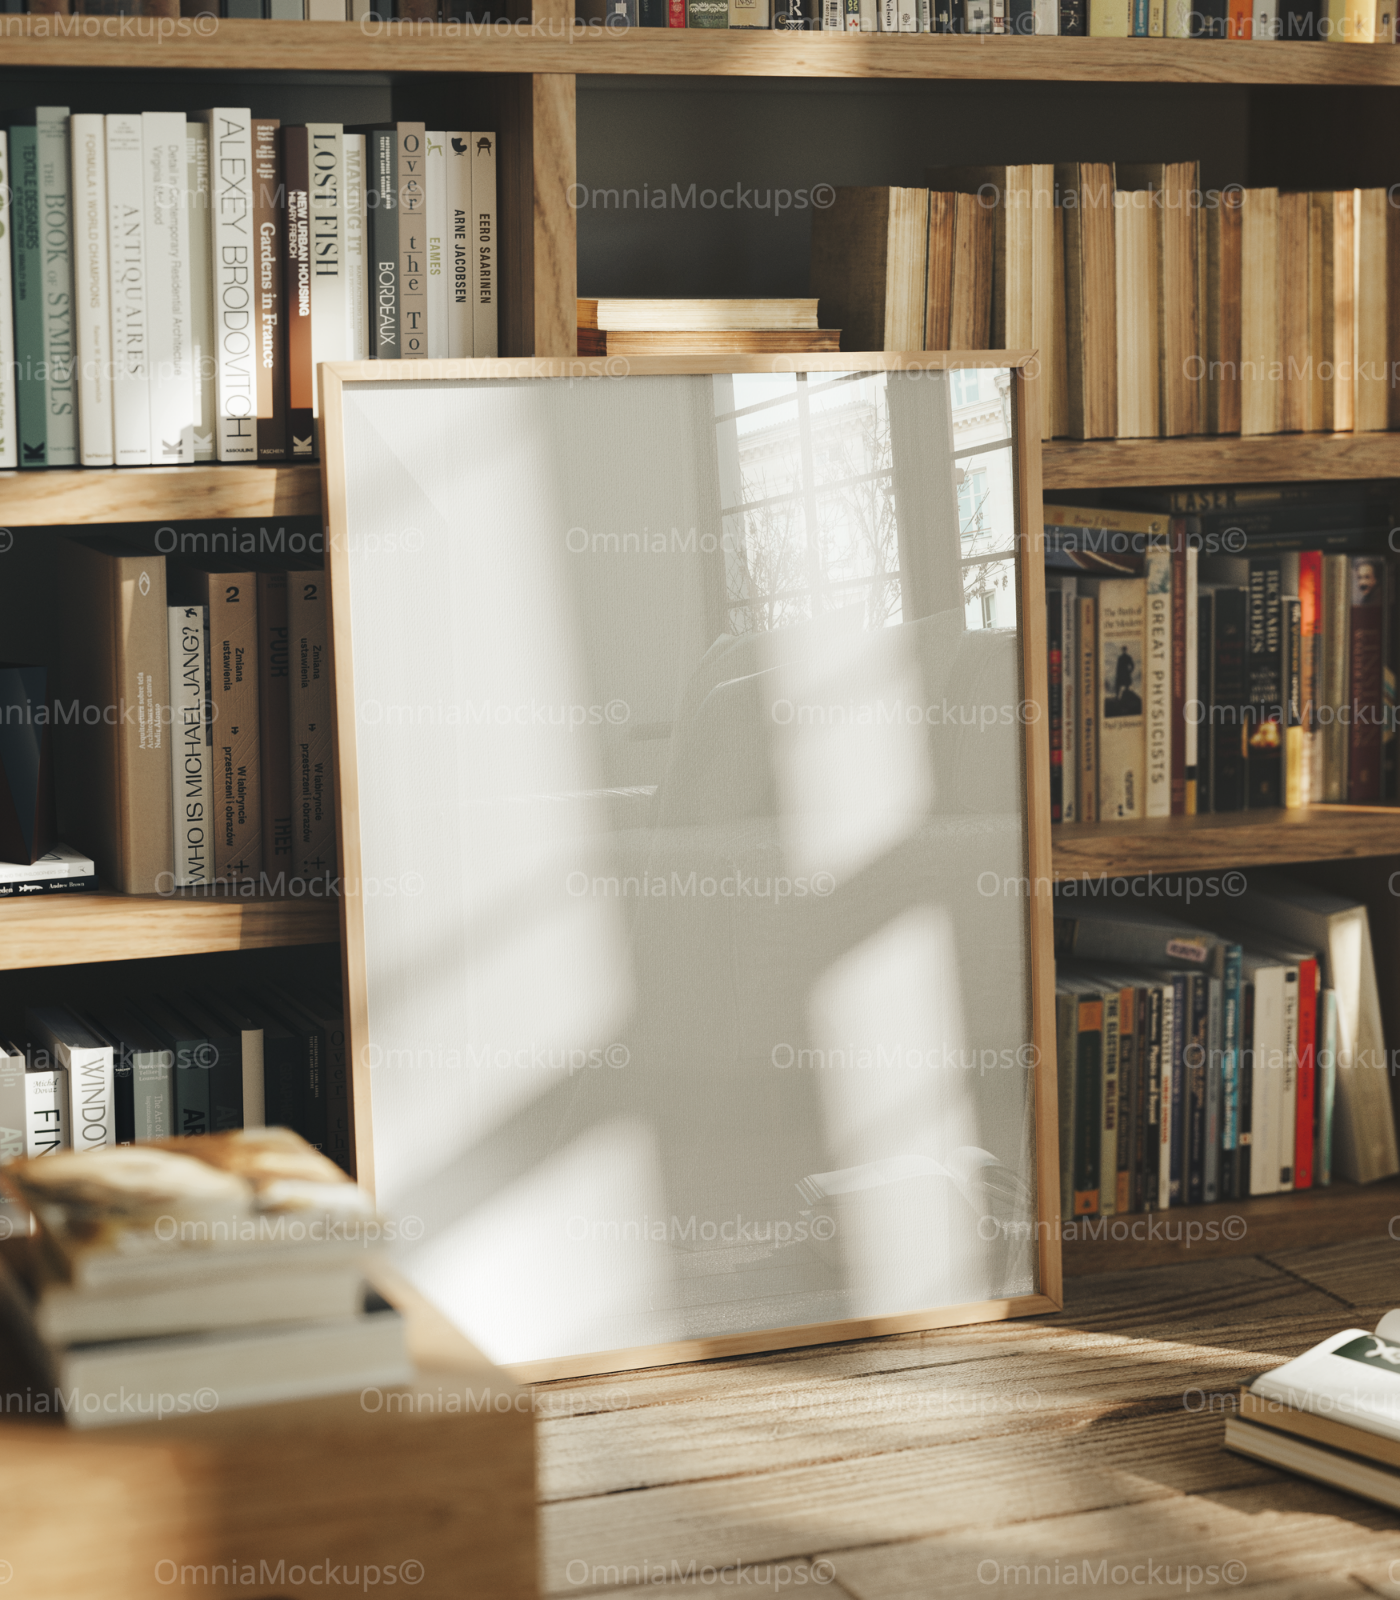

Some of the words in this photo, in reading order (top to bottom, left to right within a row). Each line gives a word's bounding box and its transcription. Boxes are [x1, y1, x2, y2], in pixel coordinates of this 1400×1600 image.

[23, 145, 37, 186] TEXTILE
[44, 163, 55, 187] THE
[86, 134, 98, 187] FORMULA
[151, 145, 164, 182] Virginia
[168, 145, 180, 173] Detail
[218, 117, 249, 234] ALEXEY
[313, 133, 338, 207] LOST
[404, 135, 420, 210] Over
[170, 176, 180, 185] in
[346, 149, 362, 230] MAKING
[25, 189, 40, 250] DESIGNERS
[88, 199, 100, 240] WORLD
[153, 185, 165, 225] McLeod
[168, 188, 182, 258] Contemporary
[288, 191, 297, 222] HILARY
[297, 191, 307, 218] NEW
[454, 209, 466, 239] ARNE
[45, 193, 68, 263] BOOK
[289, 223, 297, 259] FRENCH
[298, 220, 309, 261] URBAN
[314, 214, 340, 278] FISH
[347, 235, 362, 255] IT
[479, 213, 491, 243] EERO
[89, 243, 102, 309] CHAMPIONS
[259, 222, 277, 289] Gardens
[407, 235, 420, 290] the
[430, 237, 441, 276] EAMES
[454, 244, 467, 304] JACOBSEN
[479, 246, 492, 304] SAARINEN
[48, 270, 58, 286] OF
[120, 205, 145, 375] ANTIQUAIRES
[170, 260, 183, 314] Residential
[299, 264, 310, 317] HOUSING
[261, 293, 277, 309] in
[379, 262, 396, 346] BORDEAUX
[48, 292, 73, 416] SYMBOLS
[171, 317, 184, 376] Architecture
[222, 246, 252, 438] BRODOVITCH
[262, 313, 278, 369] France
[1172, 490, 1237, 513] LASER
[225, 586, 240, 602] 2
[303, 584, 318, 600] 2
[1250, 570, 1265, 653] RHODES
[1151, 599, 1166, 660] GREAT
[181, 626, 201, 697] JANG?
[222, 640, 234, 691] ustawienia
[234, 647, 245, 683] Zmiana
[300, 638, 311, 689] ustawienia
[312, 645, 322, 680] Zmiana
[137, 686, 145, 705] sobre
[145, 674, 153, 698] canvas
[146, 697, 153, 708] on
[1151, 671, 1166, 784] PHYSICISTS
[183, 699, 203, 798] MICHAEL
[314, 763, 324, 773] W
[222, 746, 235, 799] przestrzeni
[237, 766, 247, 776] W
[299, 743, 312, 796] przestrzeni
[186, 802, 204, 822] IS
[225, 806, 237, 847] obrazów
[302, 802, 313, 843] obrazów
[187, 827, 206, 885] WHO
[49, 882, 68, 890] Andrew
[69, 881, 85, 889] Brown
[1106, 998, 1118, 1017] THE
[33, 1078, 59, 1088] Michel
[330, 1030, 345, 1096] Over
[34, 1087, 58, 1095] Dovaz
[154, 1094, 163, 1108] The
[154, 1110, 163, 1123] Art
[155, 1124, 164, 1132] of
